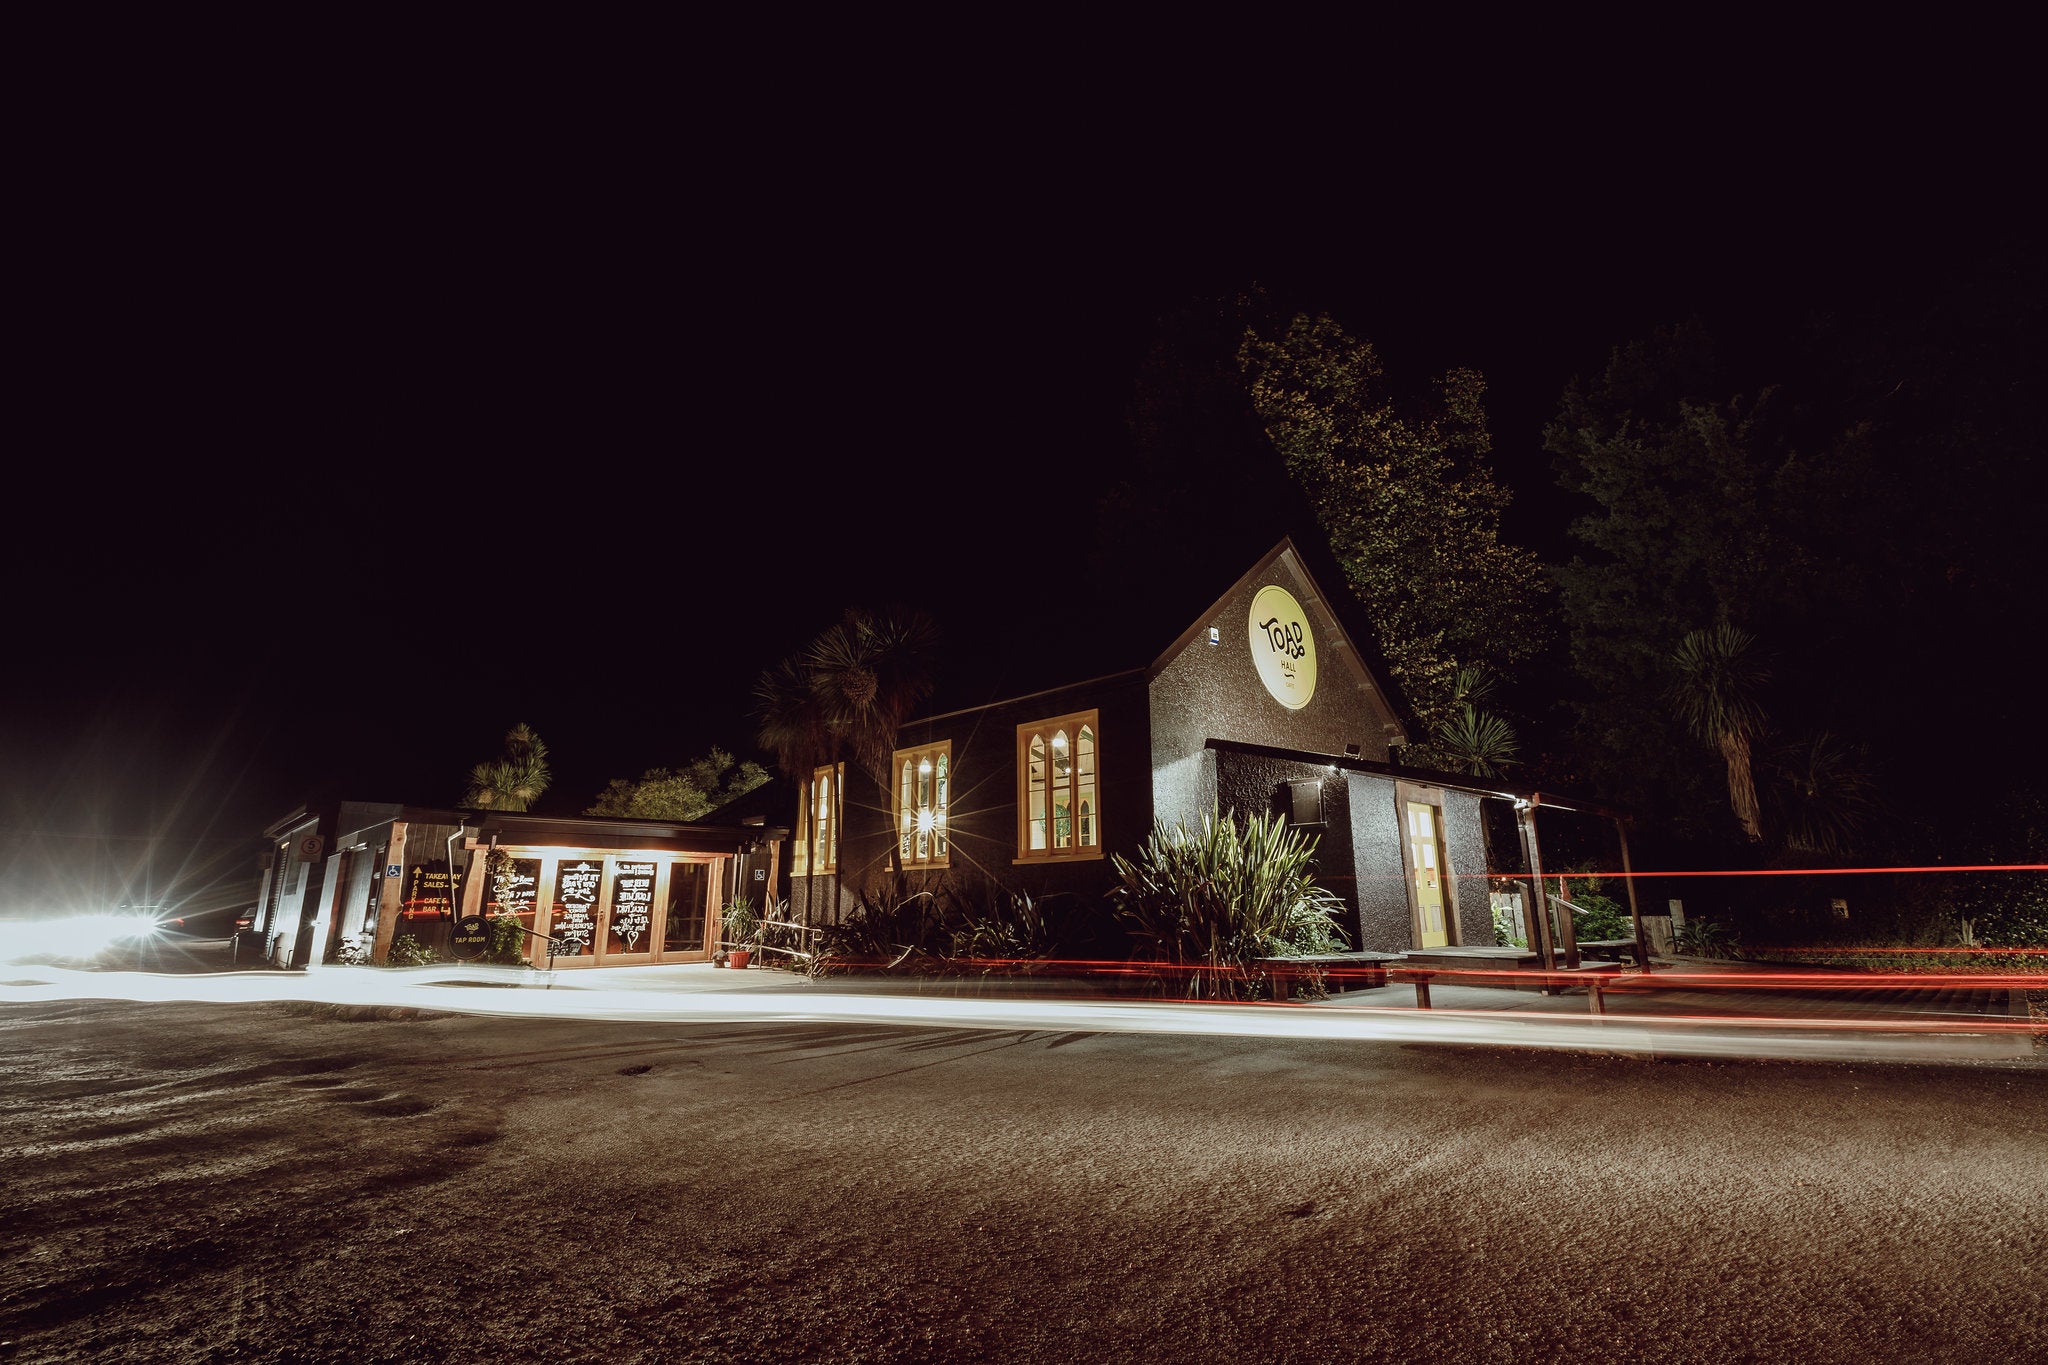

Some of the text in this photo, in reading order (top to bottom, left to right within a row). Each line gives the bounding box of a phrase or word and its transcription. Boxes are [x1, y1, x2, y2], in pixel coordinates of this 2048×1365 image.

[1259, 617, 1305, 660] TOAD
[1281, 660, 1296, 673] HALL
[308, 840, 315, 849] 5
[408, 880, 419, 919] PARKING
